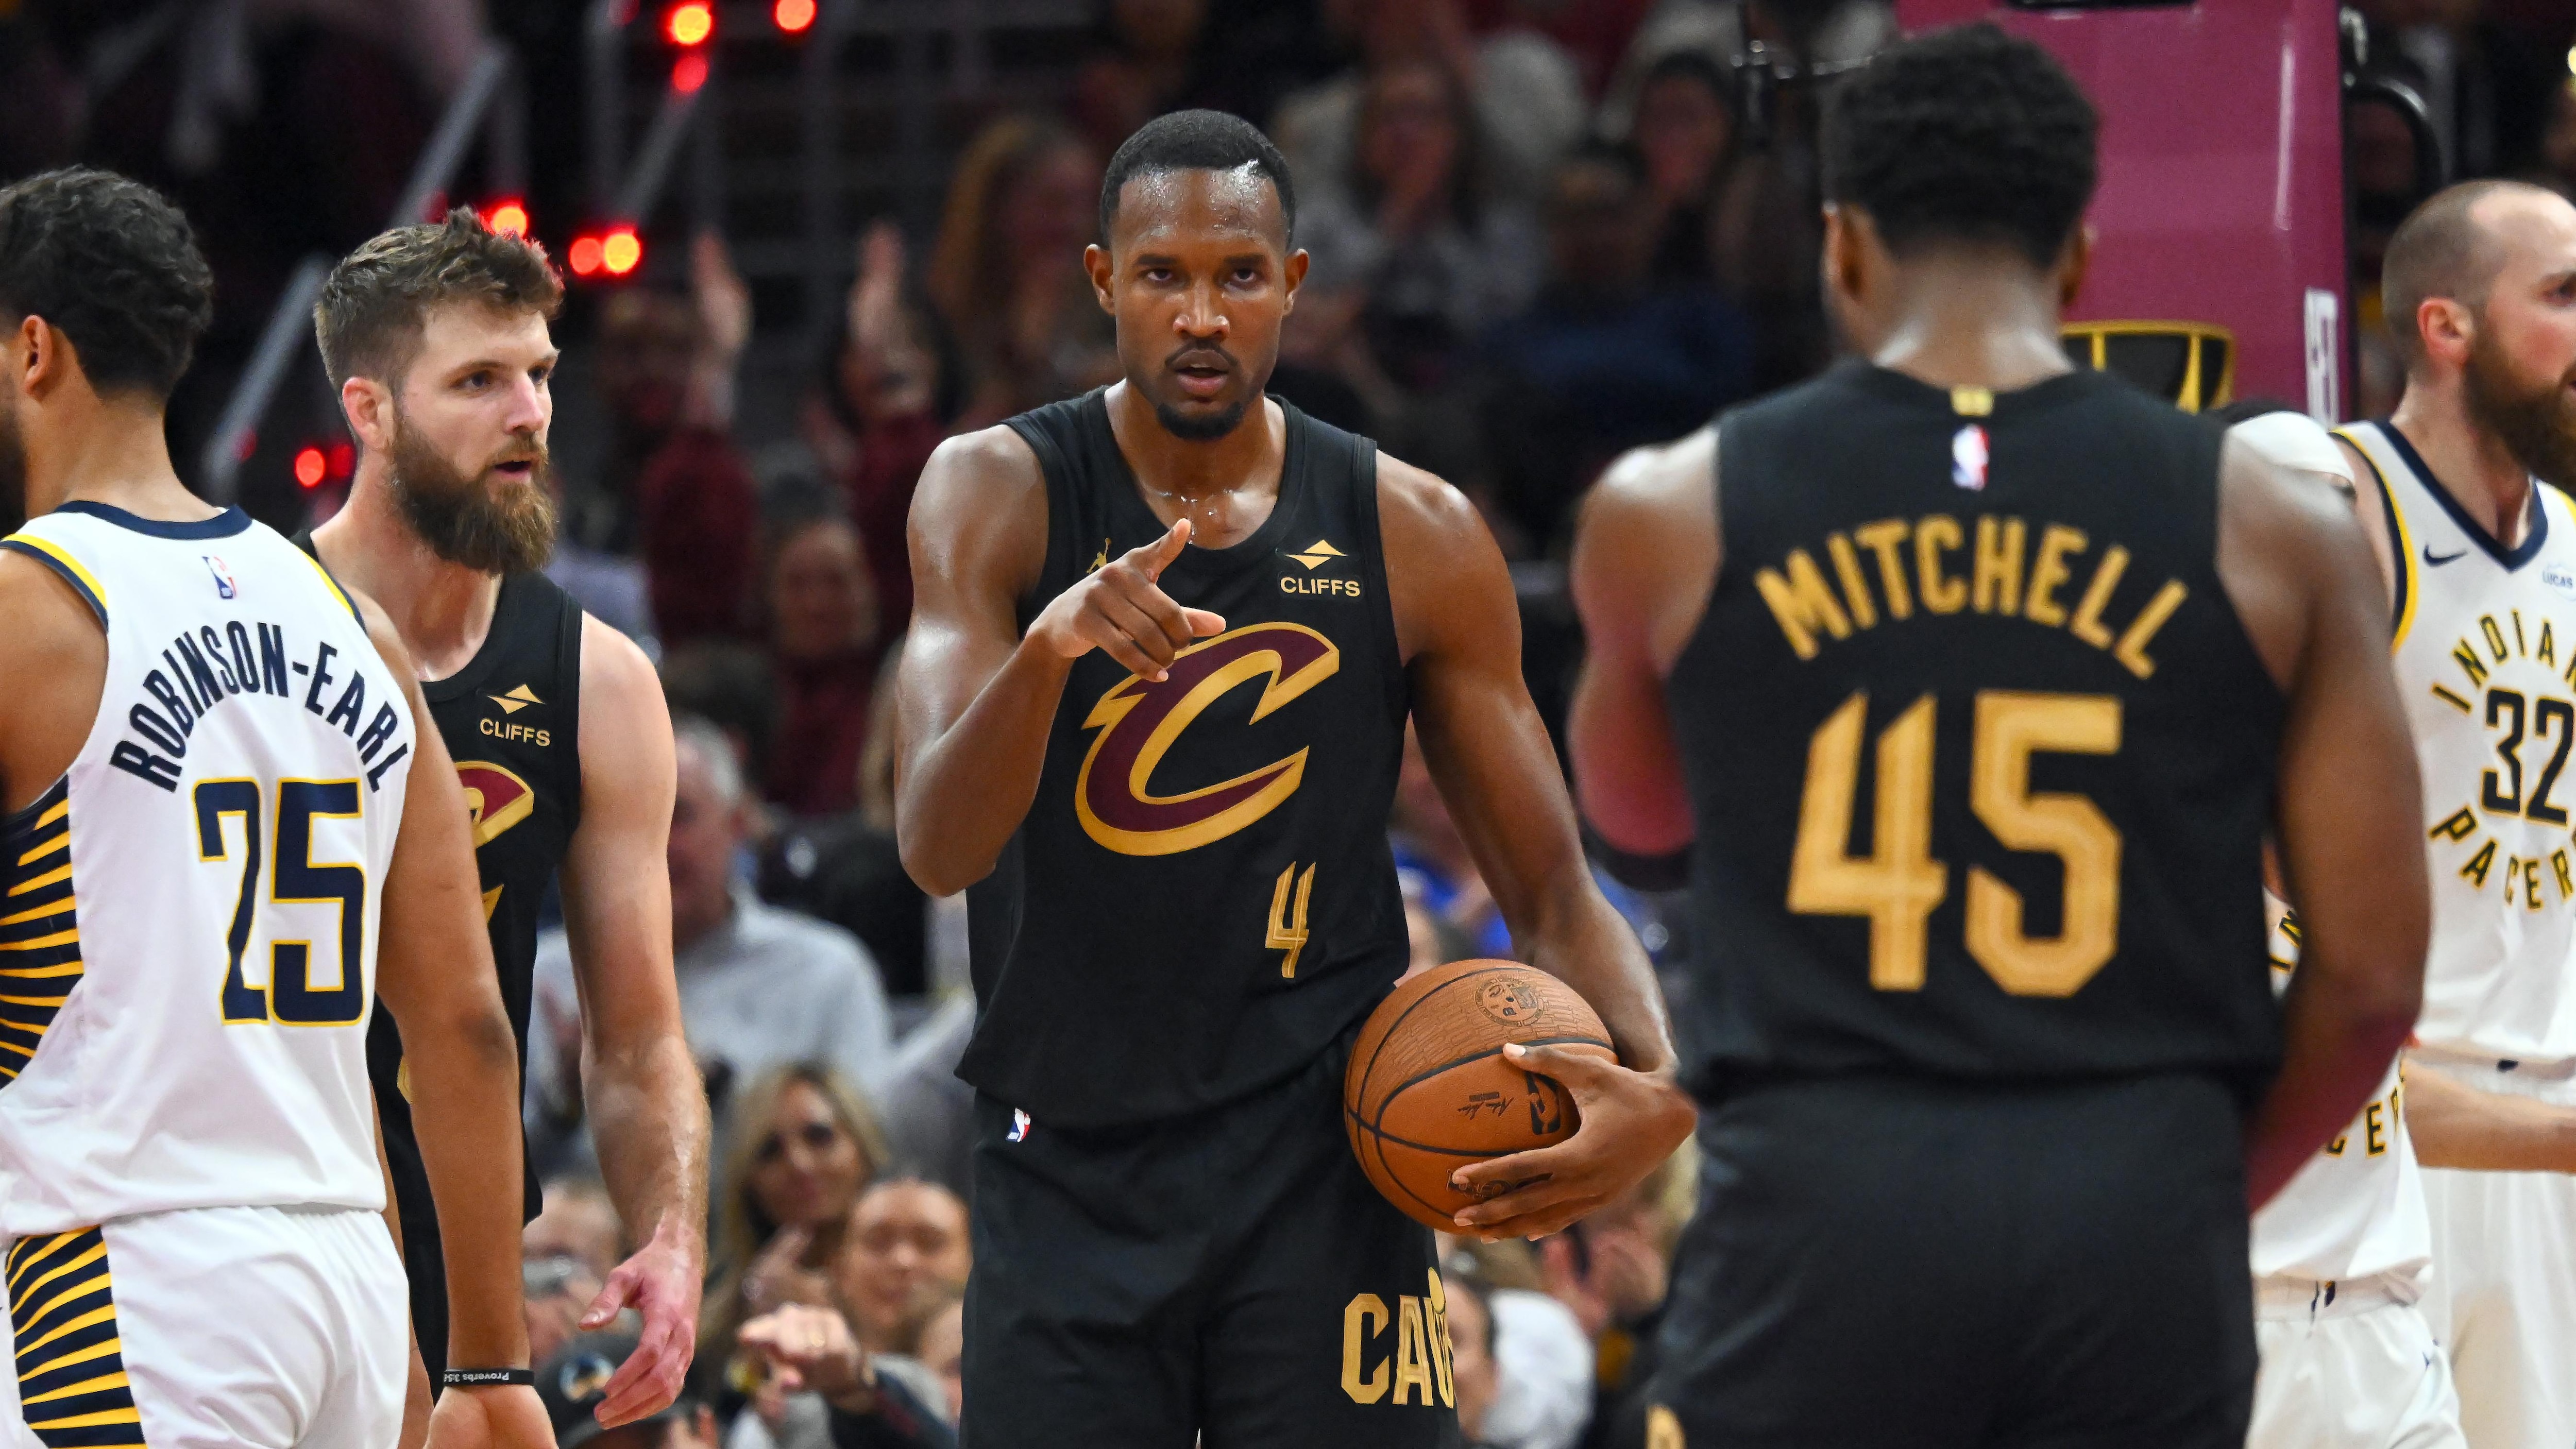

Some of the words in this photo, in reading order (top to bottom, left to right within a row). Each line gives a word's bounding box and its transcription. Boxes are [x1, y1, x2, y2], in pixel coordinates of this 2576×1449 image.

[1280, 575, 1361, 598] CLIFFS
[1755, 515, 2188, 679] MITCHELL
[110, 621, 410, 793] ROBINSON-EARL
[480, 718, 551, 747] CLIFFS
[2480, 687, 2574, 829] 32
[193, 777, 367, 1027] 25
[1786, 689, 2124, 998] 45
[2428, 803, 2576, 910] PACER
[1265, 861, 1316, 978] 4
[463, 1371, 510, 1383] Proverbs
